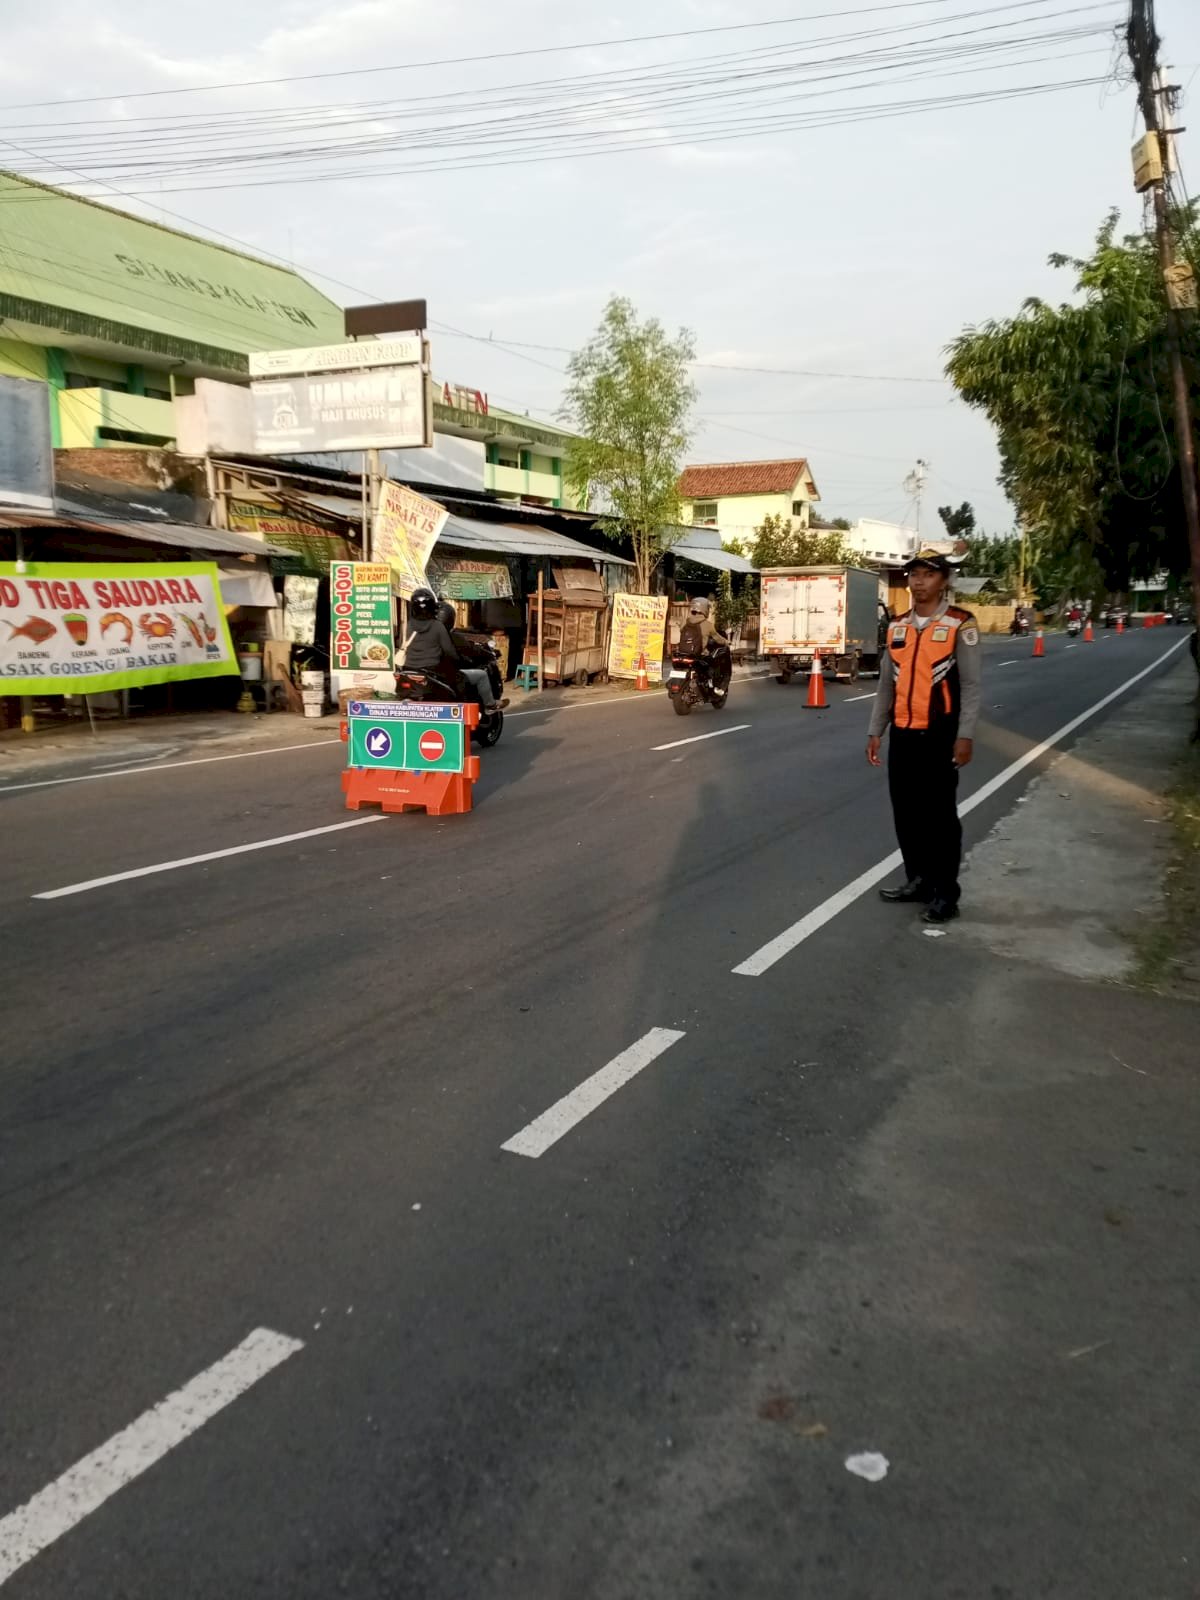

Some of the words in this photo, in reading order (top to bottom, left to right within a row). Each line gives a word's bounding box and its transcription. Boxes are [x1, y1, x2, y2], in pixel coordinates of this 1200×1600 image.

[321, 409, 344, 422] HAJI
[346, 406, 386, 421] KHUSUS
[420, 518, 436, 534] IS
[0, 578, 20, 608] D
[25, 579, 90, 610] TIGA
[92, 578, 203, 610] SAUDARA
[334, 566, 353, 615] SOTO
[653, 610, 664, 621] IS
[106, 646, 130, 656] UDANG
[334, 618, 354, 668] SAPI
[17, 651, 50, 660] BANDENG
[71, 648, 97, 659] KERANG
[126, 653, 178, 670] BAKAR
[368, 709, 389, 717] DINAS
[389, 710, 439, 718] PERHUBUNGAN
